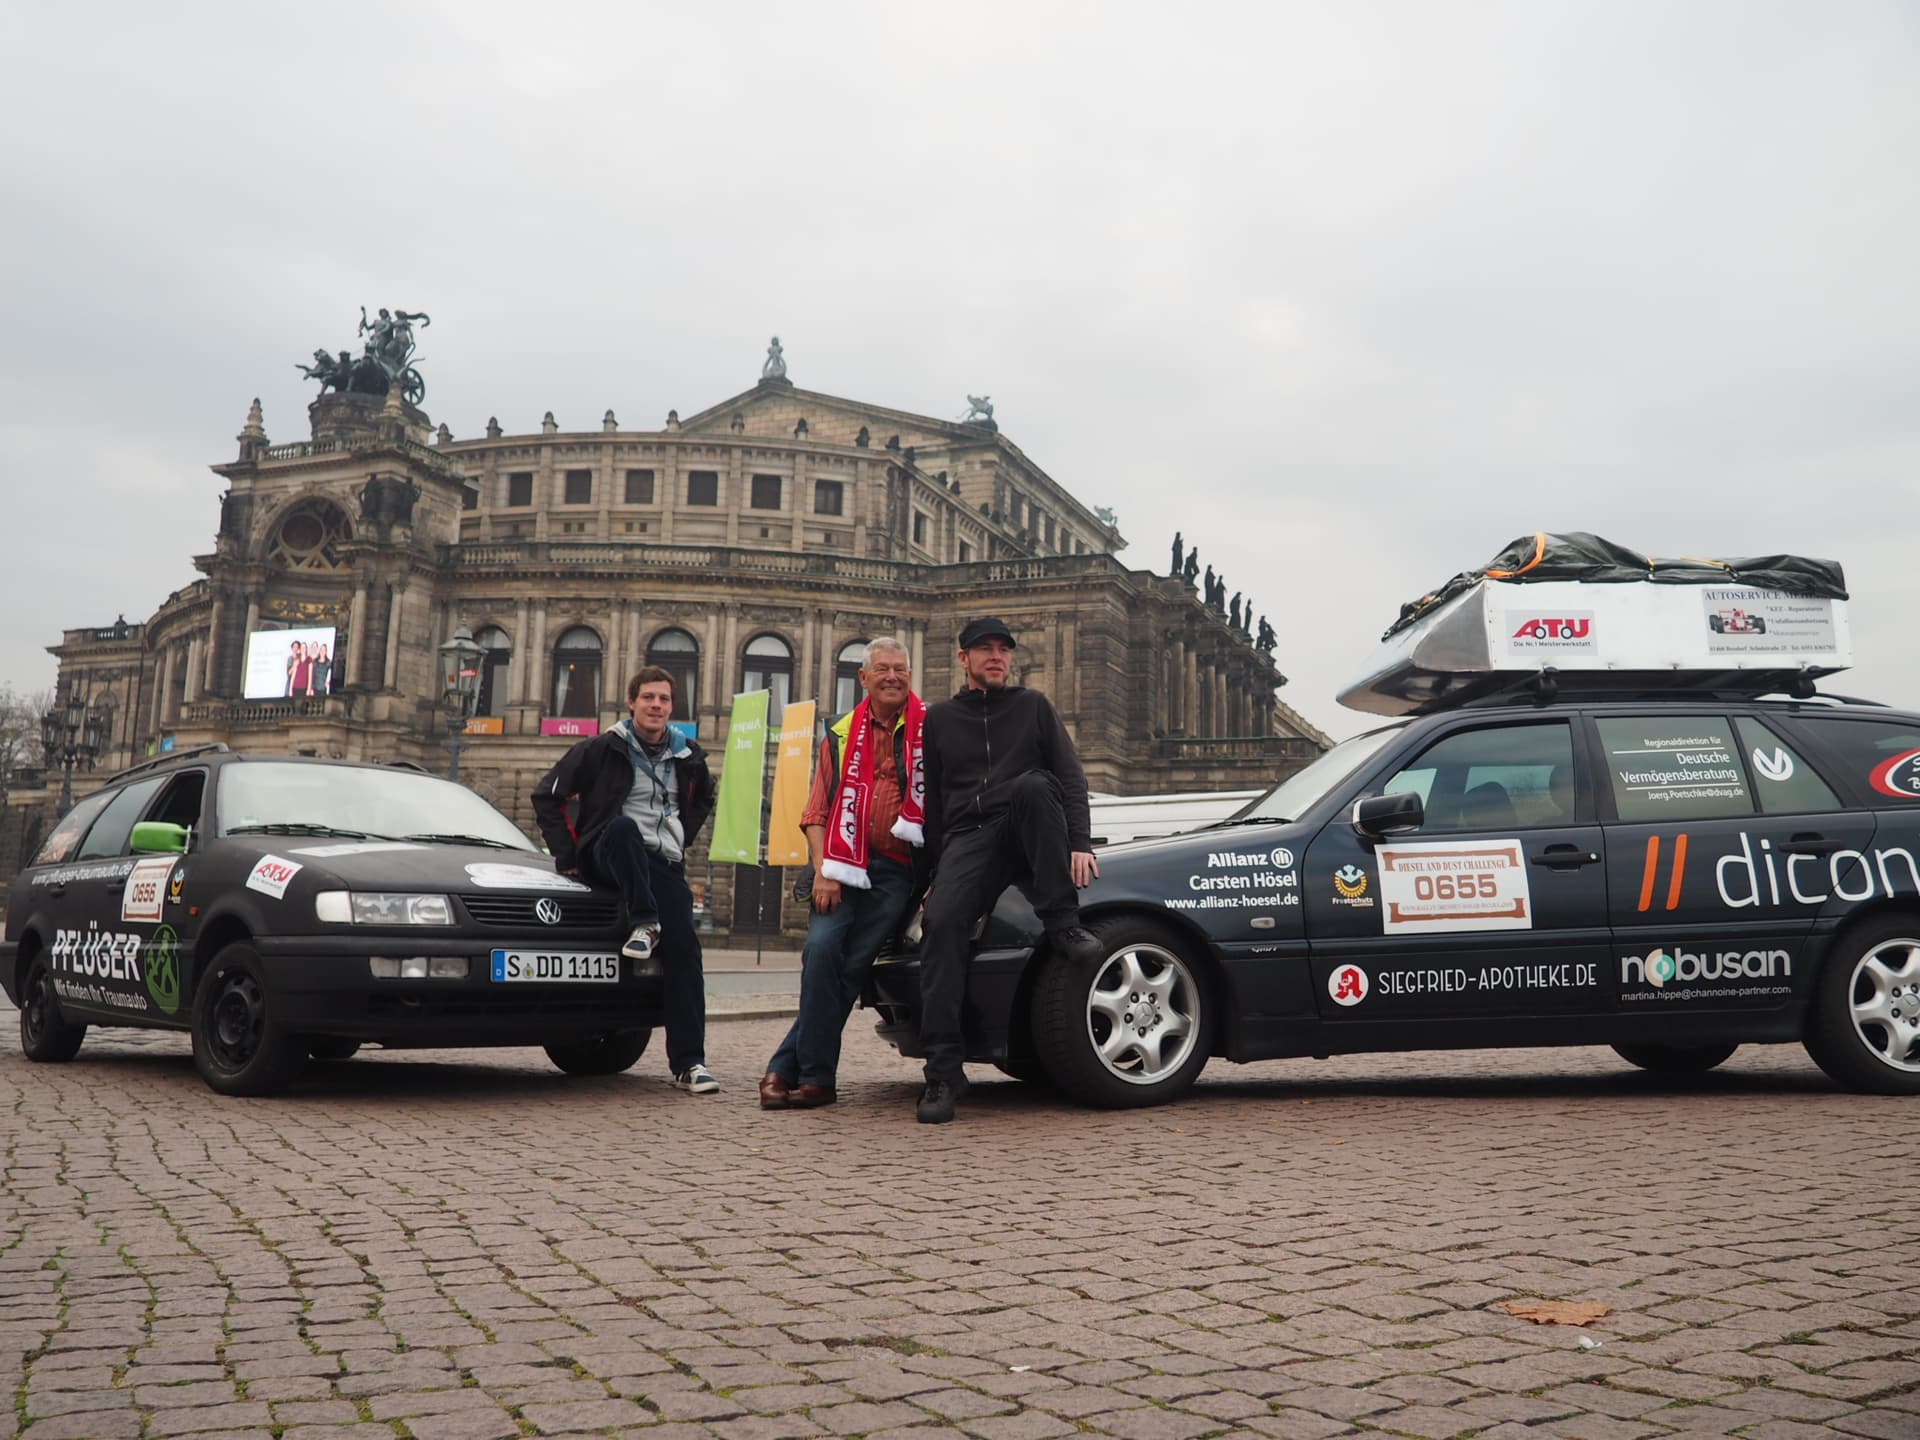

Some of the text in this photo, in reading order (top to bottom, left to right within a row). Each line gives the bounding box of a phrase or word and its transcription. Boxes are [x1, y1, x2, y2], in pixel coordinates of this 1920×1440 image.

[1705, 591, 1781, 600] AUTOSERVICE
[558, 720, 580, 735] ein
[1644, 736, 1721, 748] Regionaldirektion für
[1676, 752, 1730, 764] Deutsche
[1620, 769, 1738, 784] Vermögensberatung
[1208, 852, 1268, 868] Allianz
[1398, 859, 1506, 873] DIESEL AND DUST CHALLENGE
[1189, 870, 1298, 890] Carsten Hösel
[1415, 874, 1498, 901] 0655
[1164, 893, 1299, 909] www.allianz-hoesel.de
[52, 920, 141, 981] PFLÜGER
[507, 955, 521, 978] S
[536, 956, 563, 978] DD
[568, 956, 617, 979] 1115
[1379, 963, 1597, 995] SIEGFRIED-APOTHEKE.DE
[53, 978, 66, 997] Wir
[100, 986, 148, 1010] Traumauto
[1622, 986, 1792, 1001] martina.hippe@channoine-partner.com
